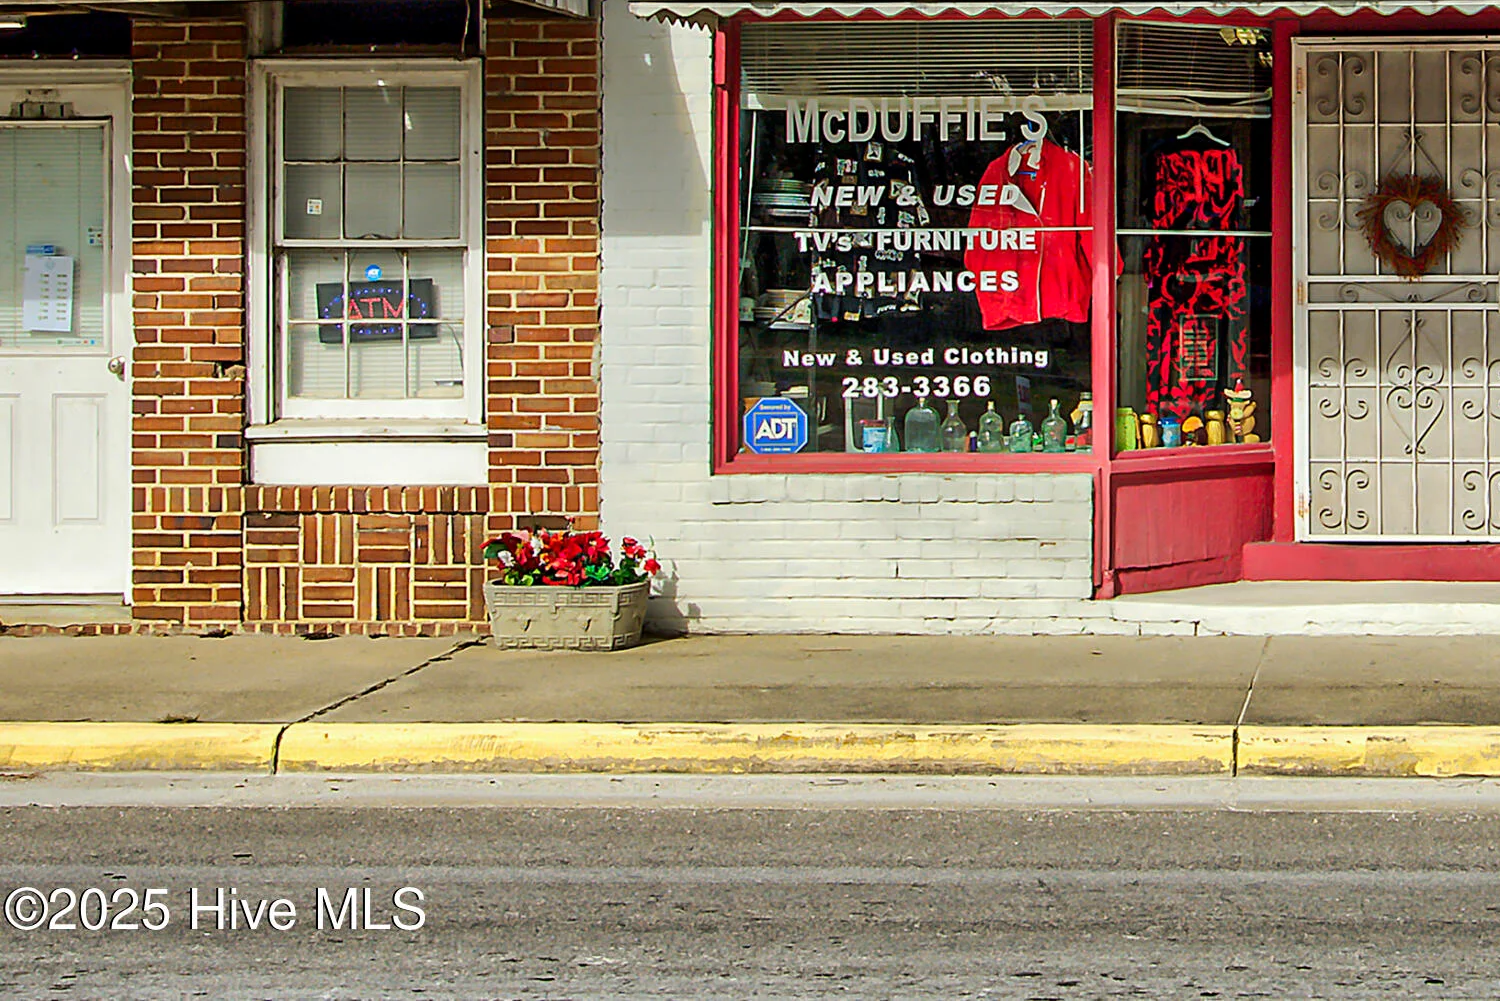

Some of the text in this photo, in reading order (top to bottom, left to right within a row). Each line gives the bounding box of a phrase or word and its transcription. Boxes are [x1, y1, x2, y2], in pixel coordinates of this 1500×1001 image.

[786, 96, 1048, 143] McDUFFIE'S
[811, 184, 1021, 206] NEW & USED
[794, 231, 852, 252] TV's
[876, 230, 1036, 252] FURNITURE
[811, 270, 1019, 292] APPLIANCES
[349, 297, 405, 320] ATM
[783, 347, 1049, 368] New & Used Clothing
[841, 376, 991, 398] 283-3366
[755, 418, 797, 440] ADT
